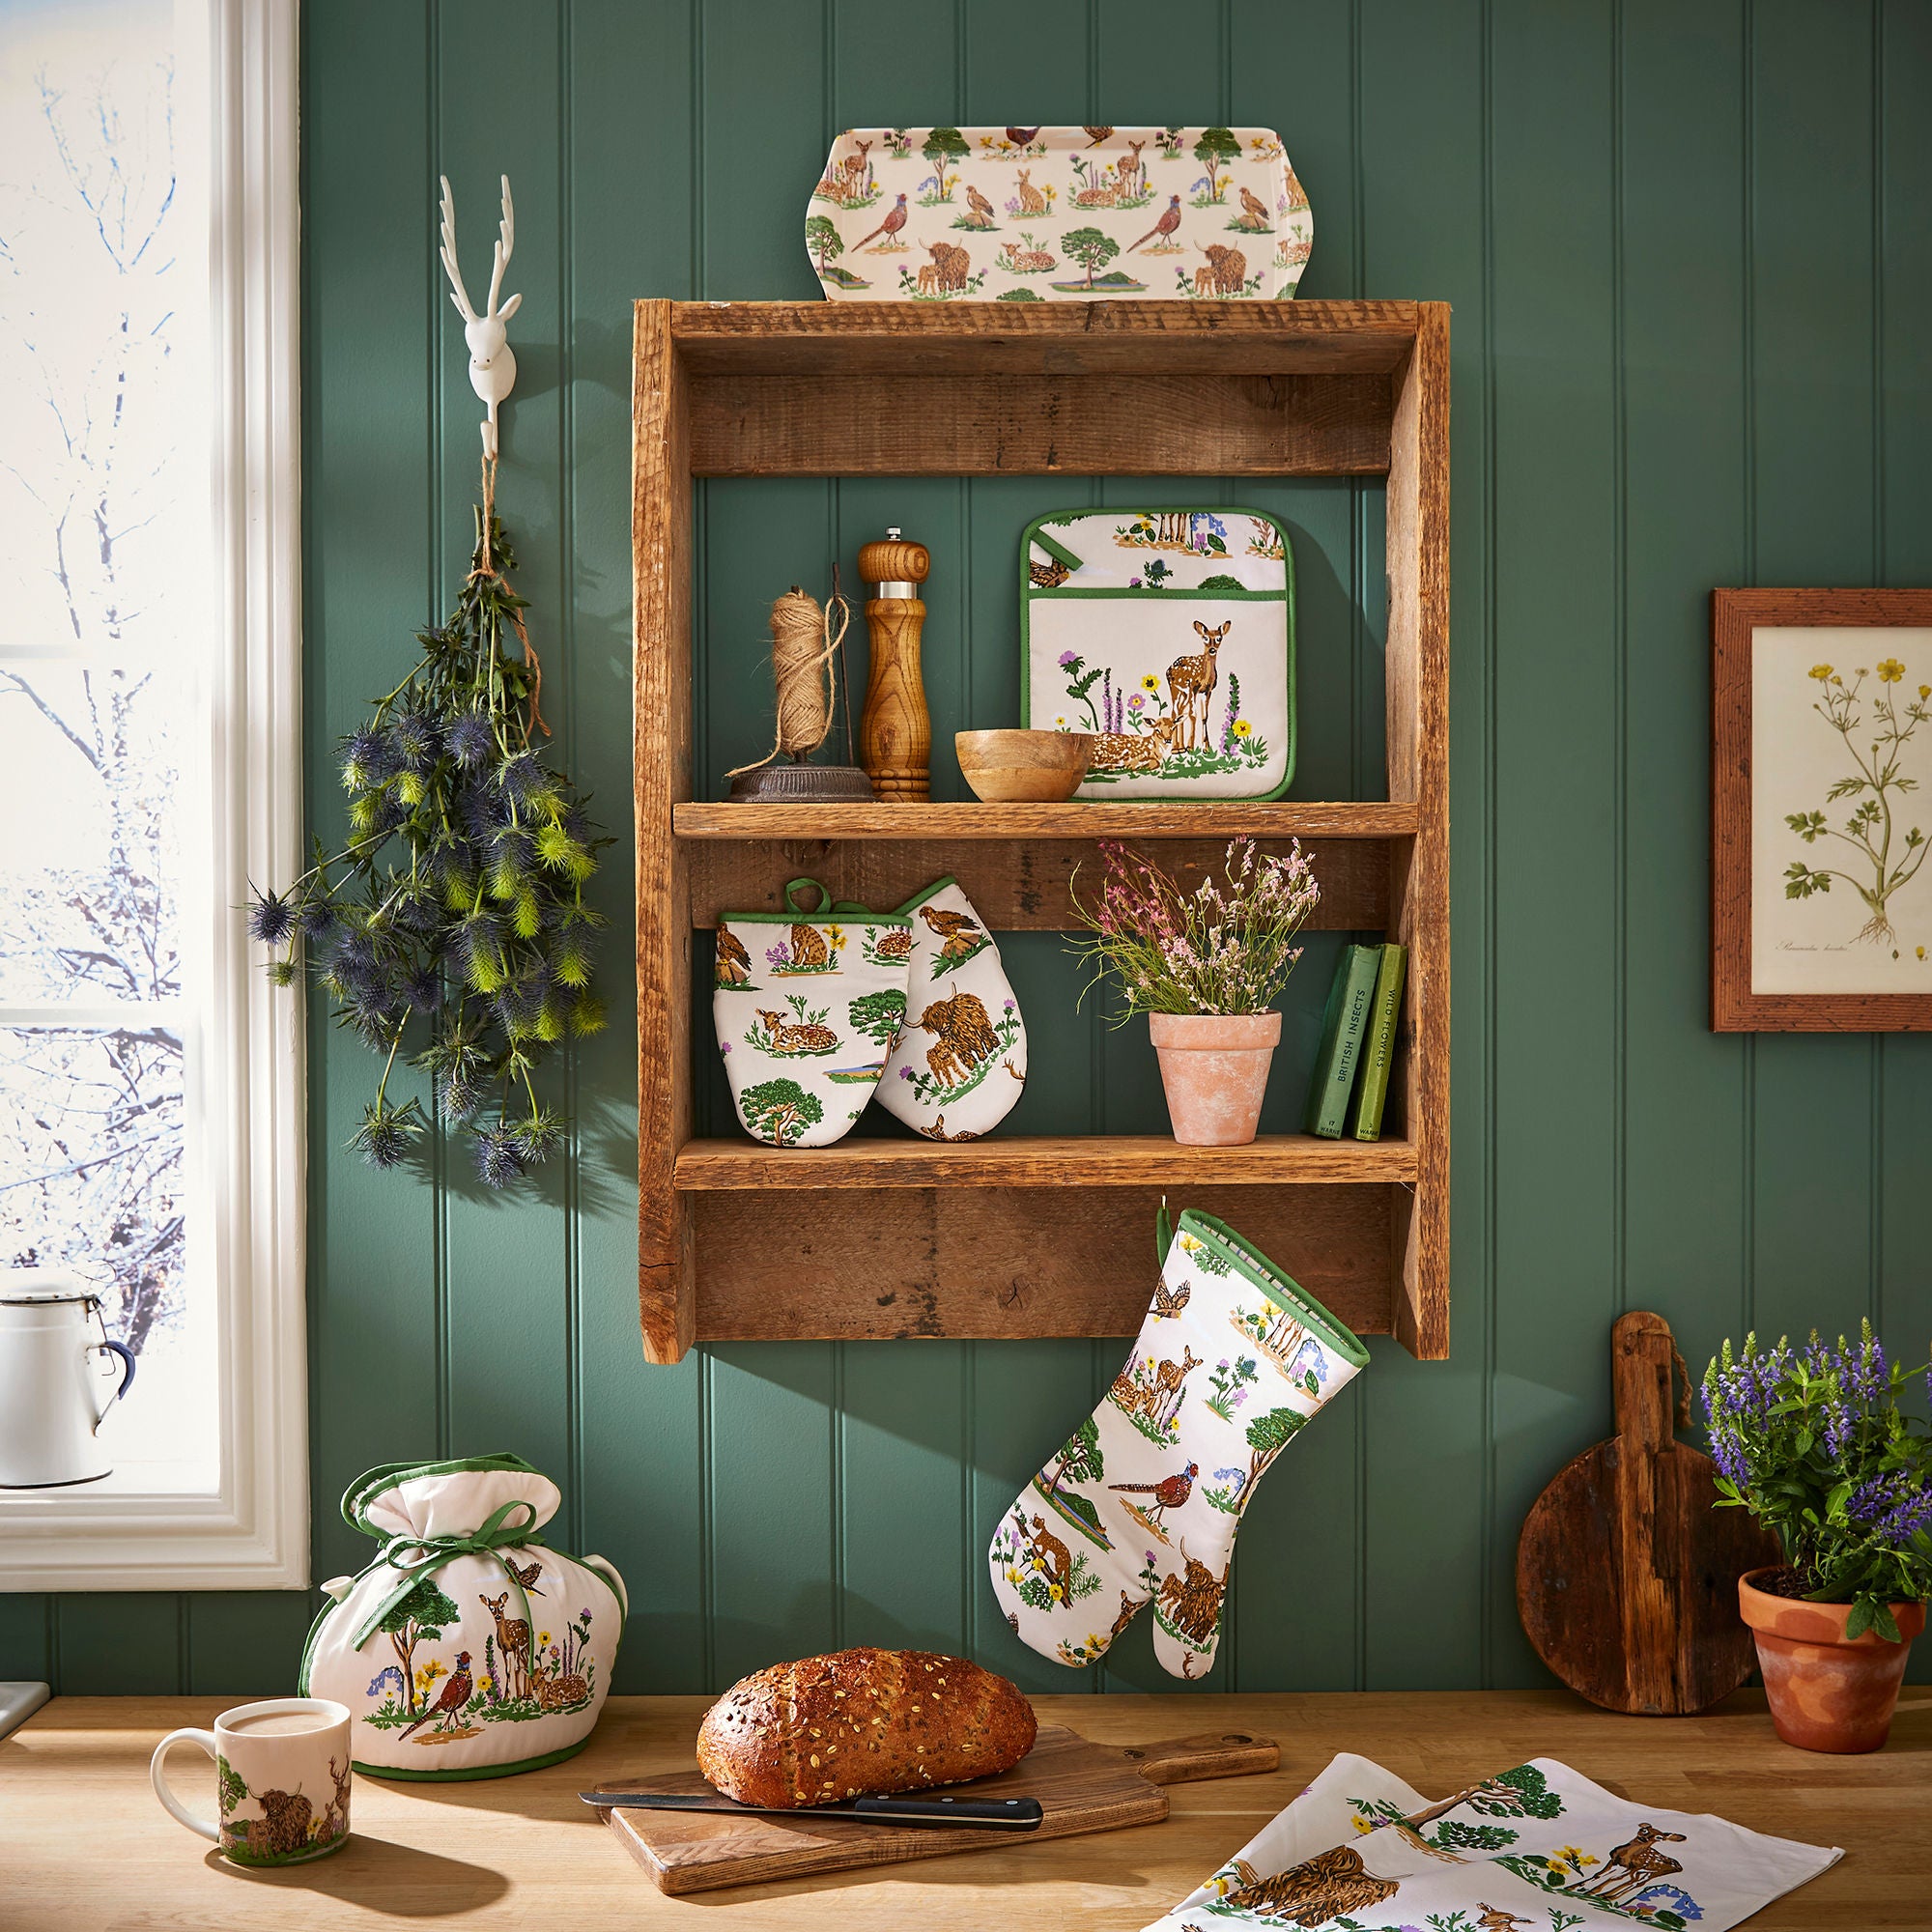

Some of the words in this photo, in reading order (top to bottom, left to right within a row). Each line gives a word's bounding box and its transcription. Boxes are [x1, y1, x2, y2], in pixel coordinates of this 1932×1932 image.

[1384, 989, 1396, 1016] WILD
[1337, 1041, 1354, 1083] BRITISH
[1348, 989, 1365, 1036] INSECTS
[1376, 1021, 1391, 1068] FLOWERS
